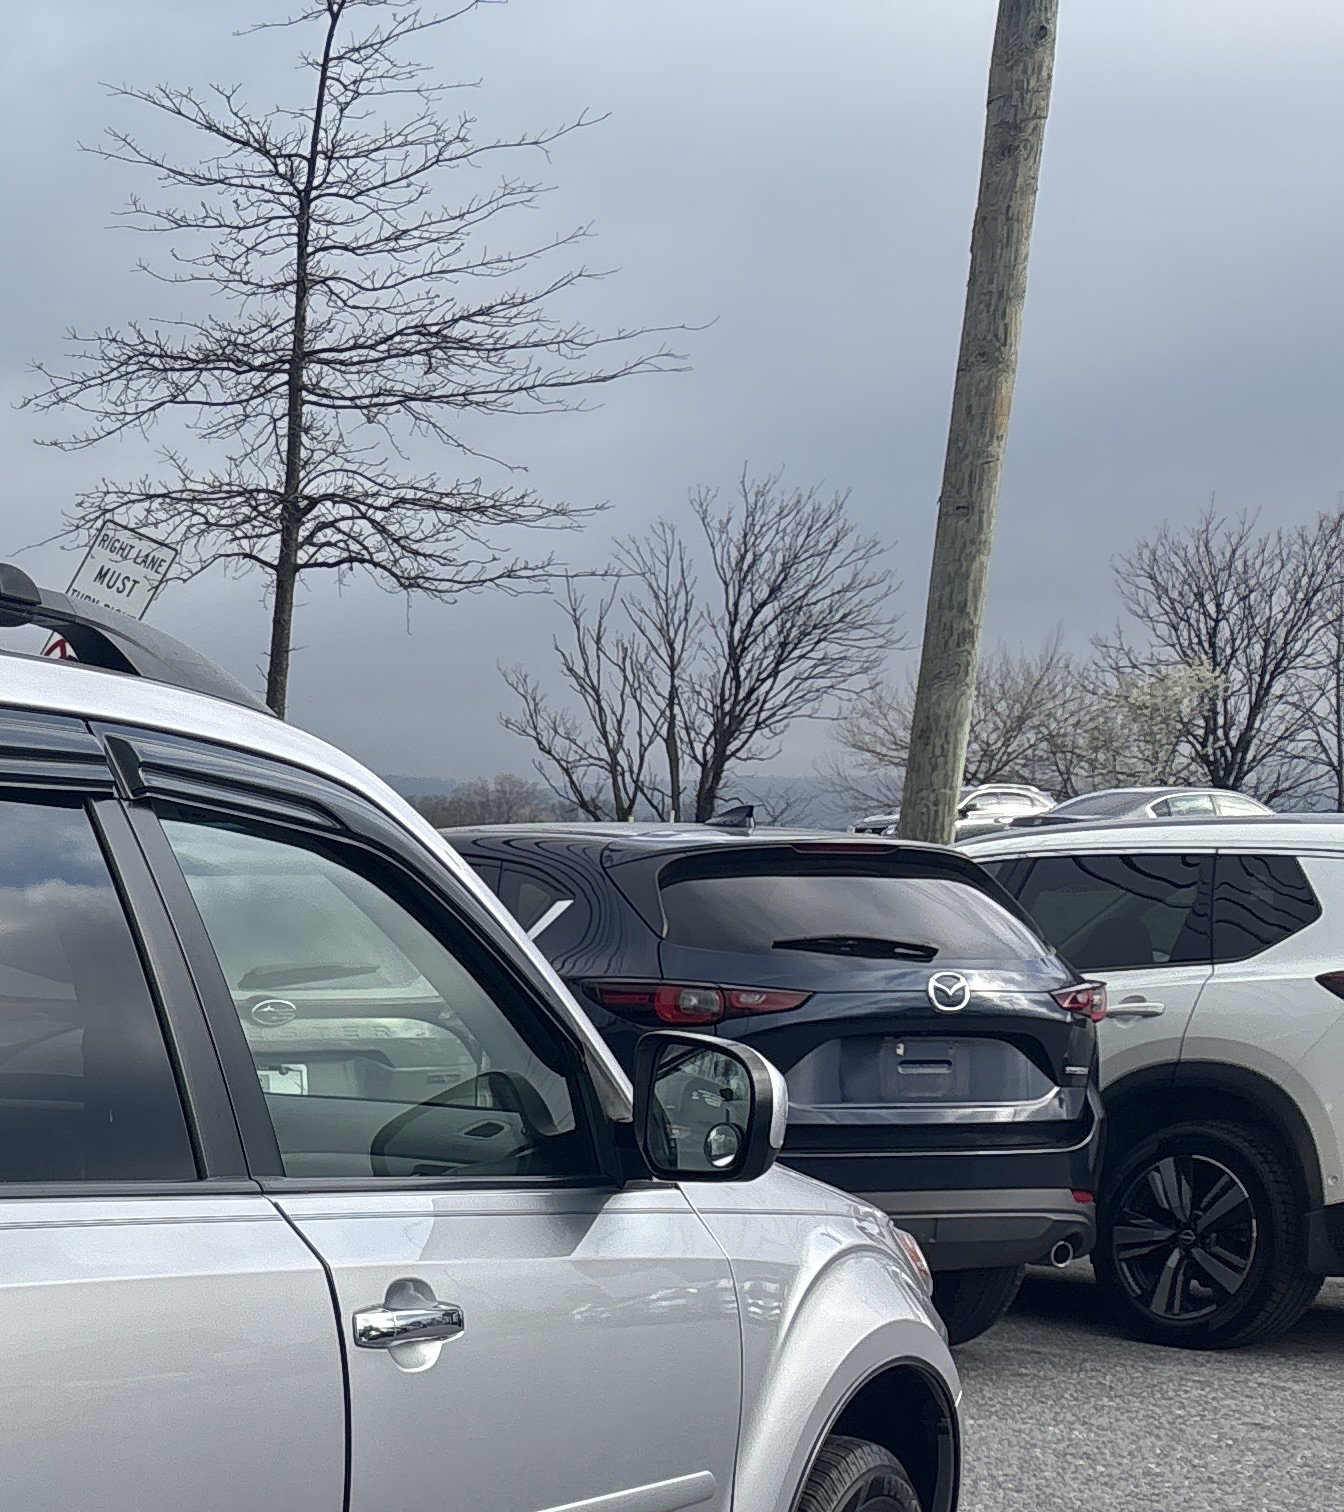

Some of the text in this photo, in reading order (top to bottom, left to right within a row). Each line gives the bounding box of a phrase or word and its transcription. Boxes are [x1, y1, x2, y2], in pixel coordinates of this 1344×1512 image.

[97, 533, 167, 575] RIGHT LANE
[93, 565, 140, 598] MUST
